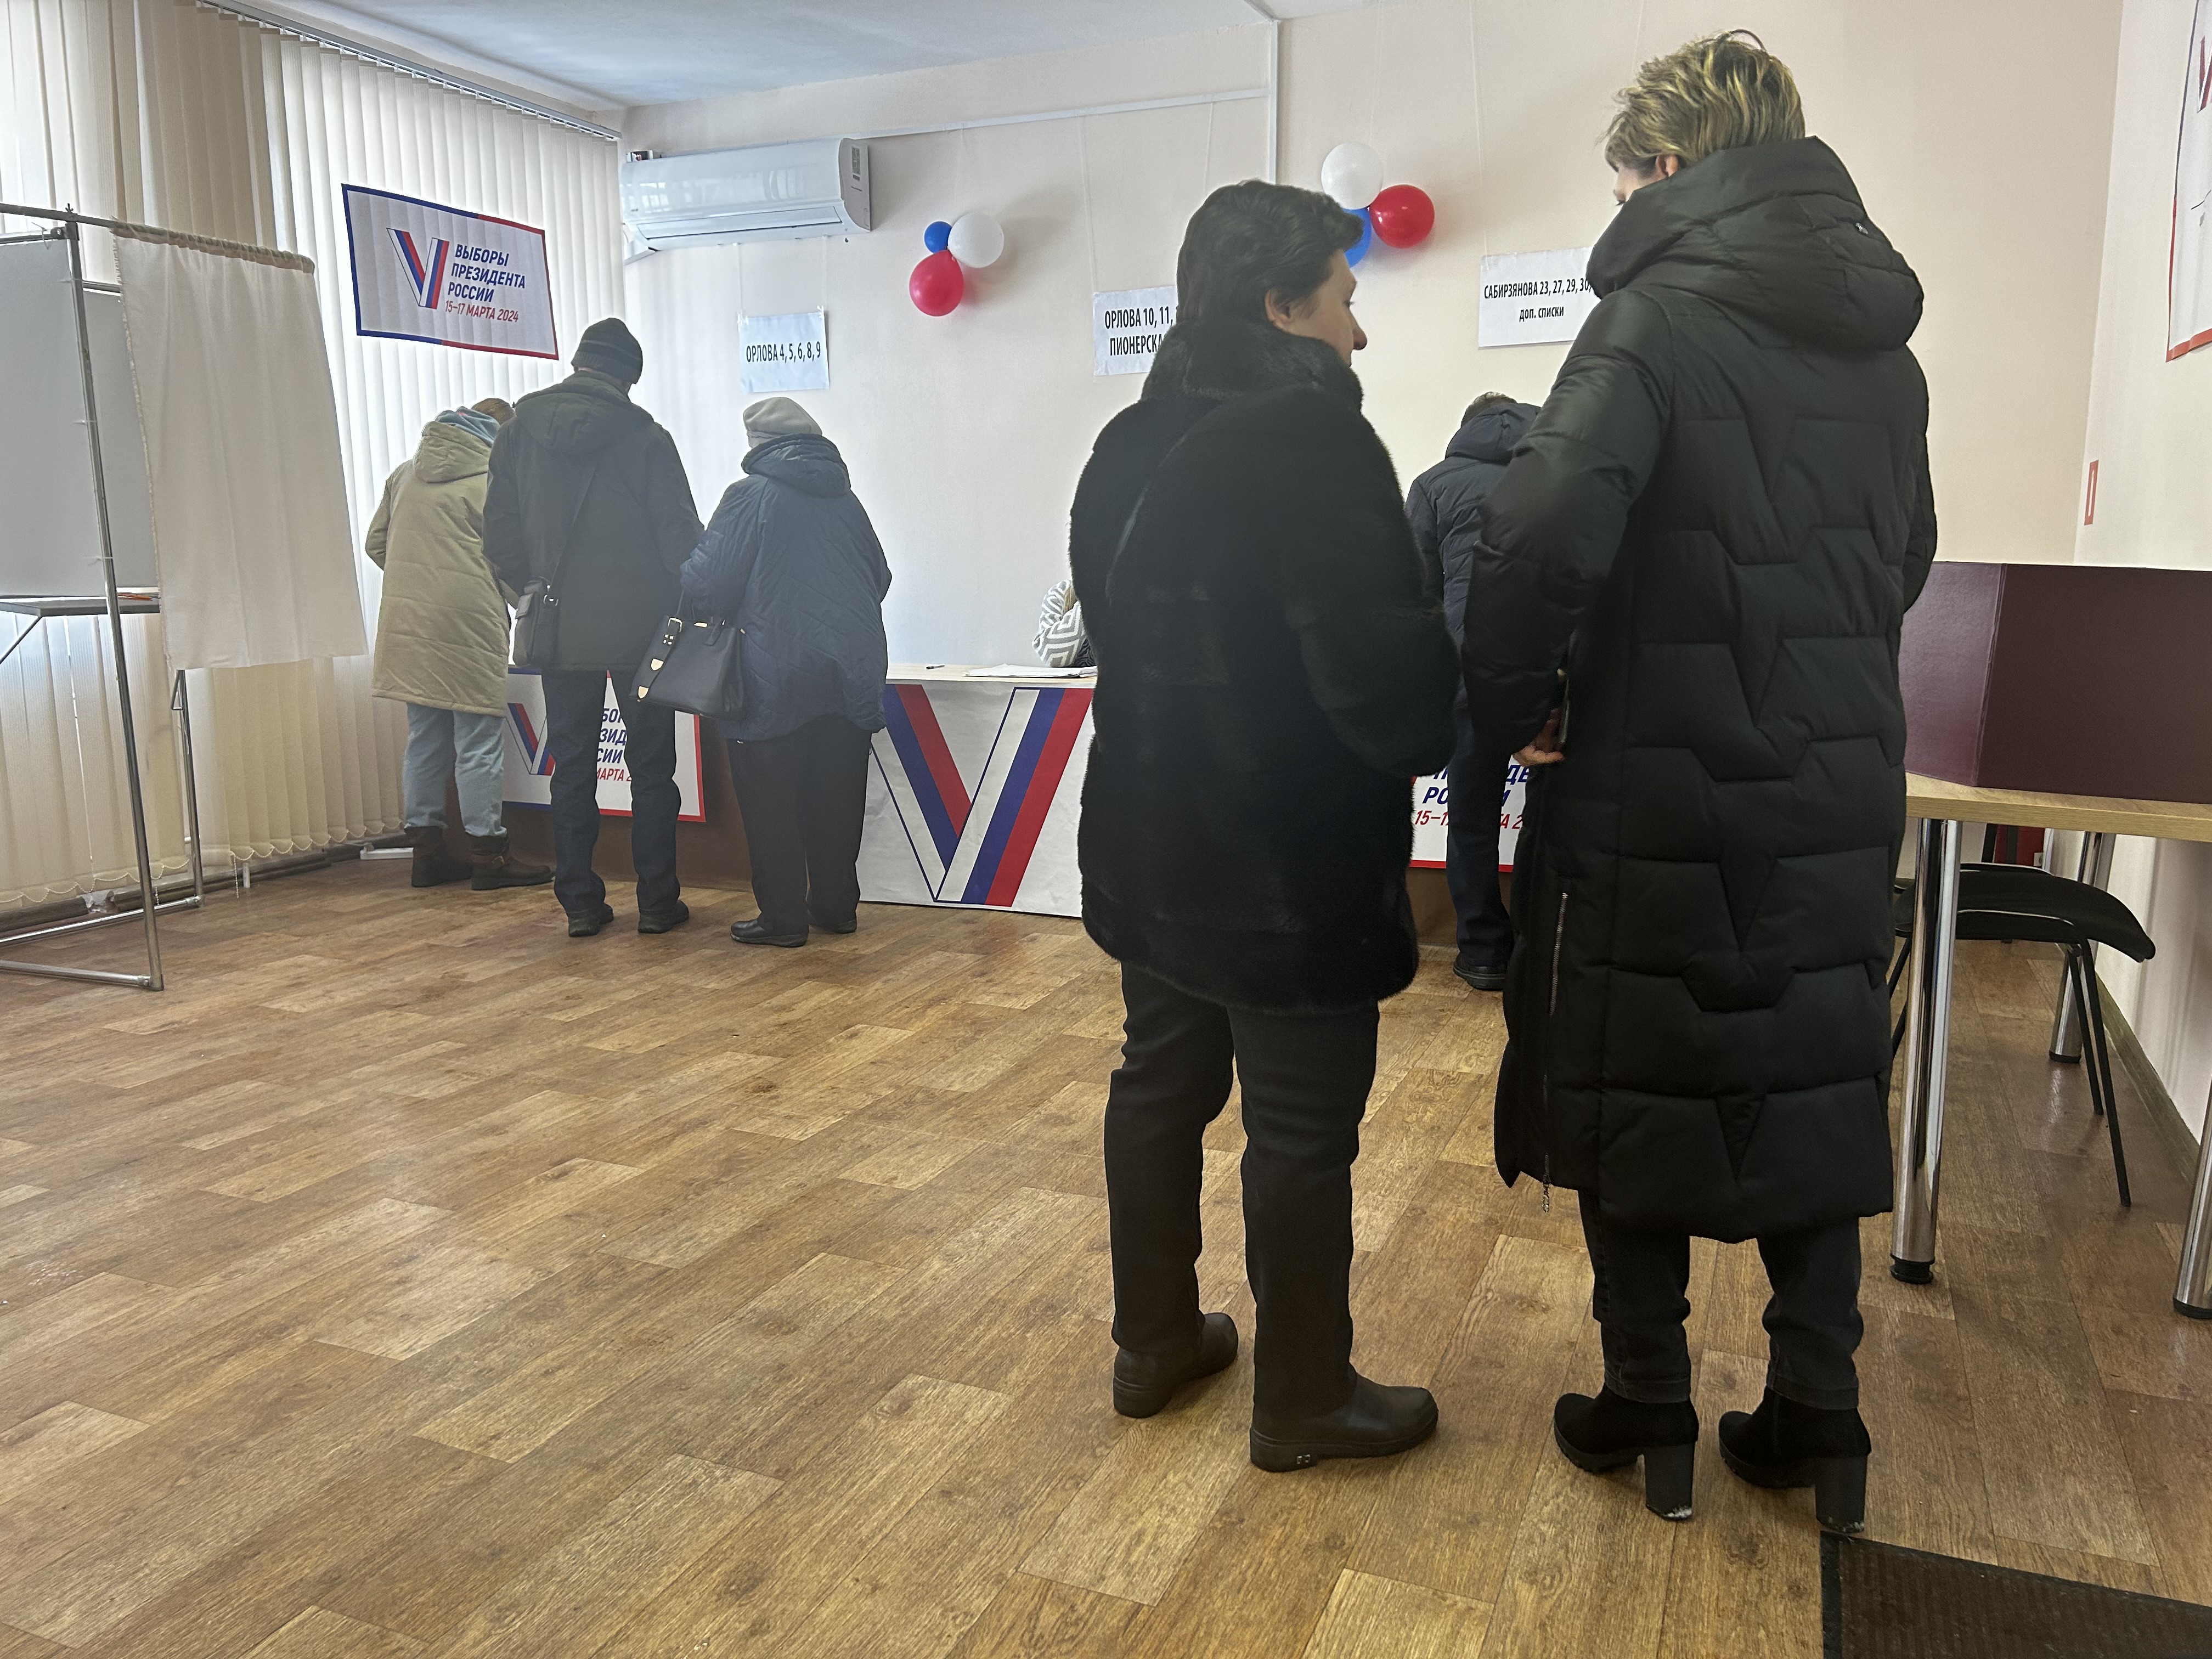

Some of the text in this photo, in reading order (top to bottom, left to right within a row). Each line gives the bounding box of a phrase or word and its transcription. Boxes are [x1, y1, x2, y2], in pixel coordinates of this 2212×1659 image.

[455, 244, 509, 267] ВЫБОРЫ
[451, 262, 525, 289] ПРЕЗИДЕНТА
[448, 281, 494, 303] РОССИИ
[1484, 281, 1538, 299] САБИРЗЯНОВА
[1539, 281, 1551, 296] 23,
[1553, 280, 1564, 295] 27,
[1566, 279, 1578, 294] 29,
[466, 304, 495, 320] МАРТА
[497, 308, 518, 323] 2024
[1105, 306, 1173, 329] ОРЛОВА 10, 11,
[746, 341, 821, 363] ОРЛОВА 4, 5, 6, 8, 9
[1414, 810, 1448, 826] 15–1
